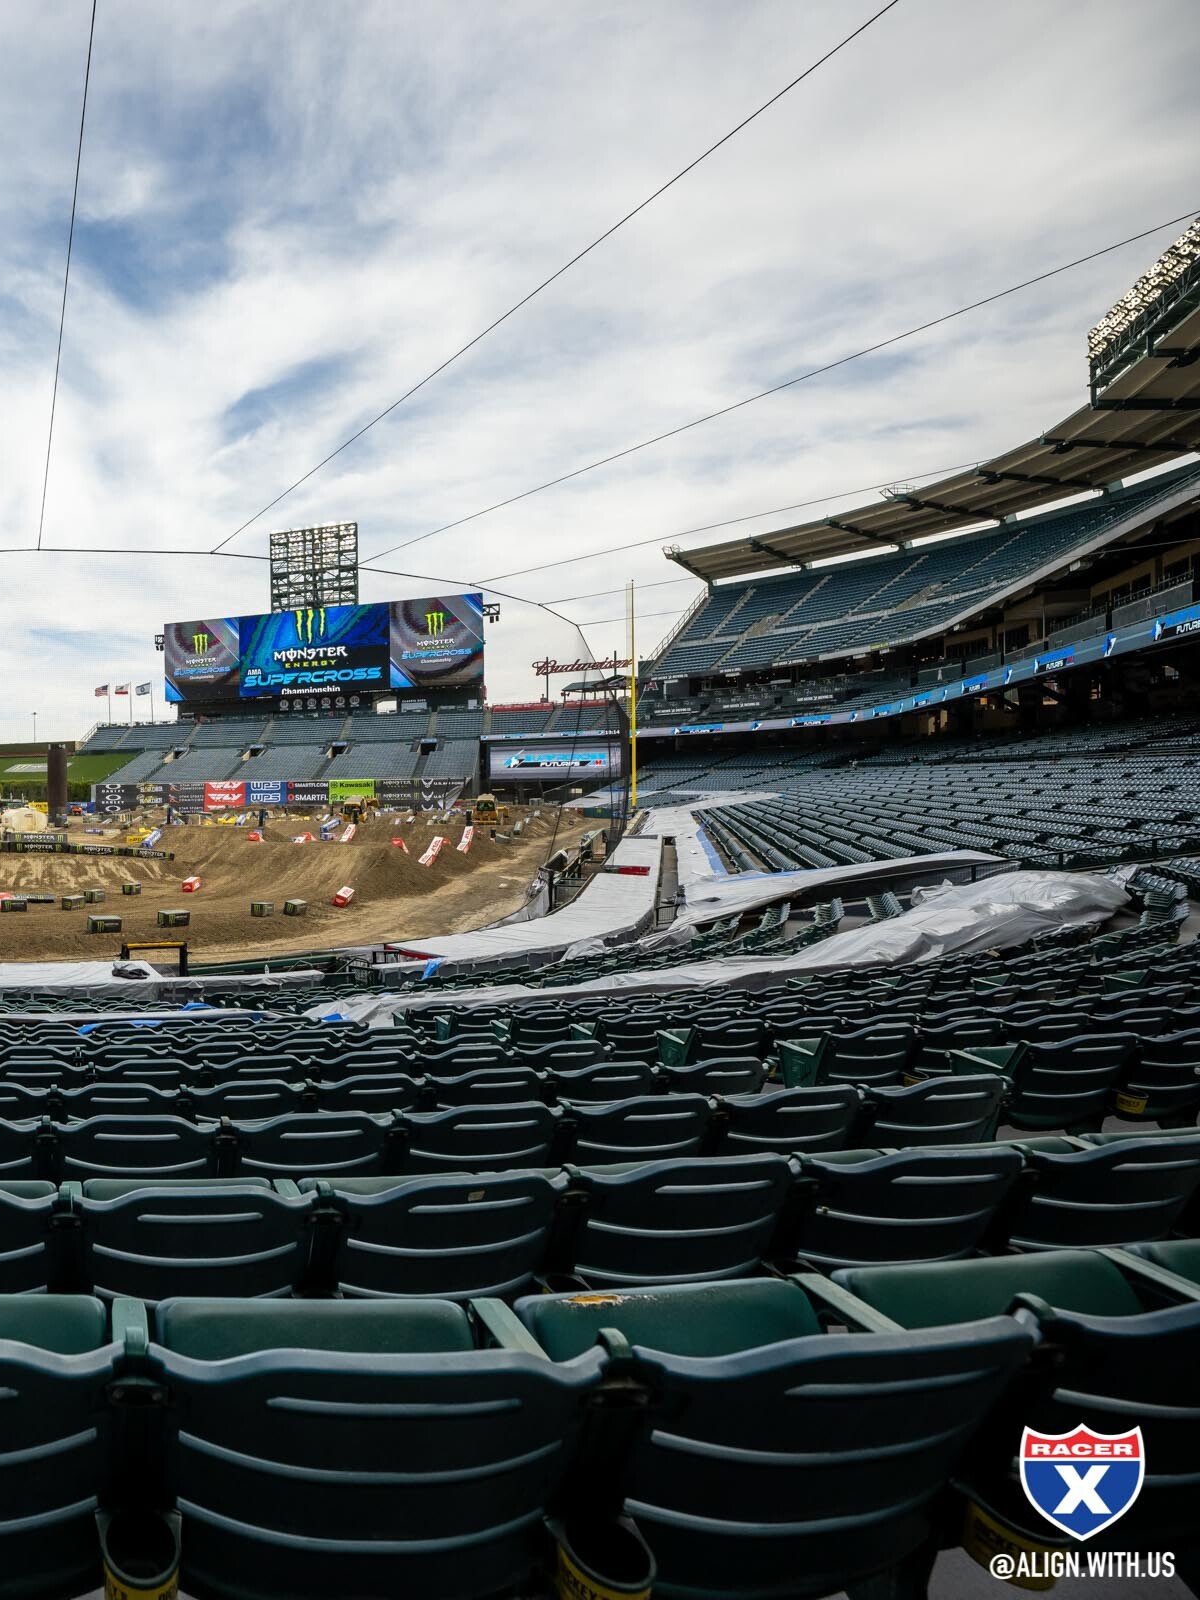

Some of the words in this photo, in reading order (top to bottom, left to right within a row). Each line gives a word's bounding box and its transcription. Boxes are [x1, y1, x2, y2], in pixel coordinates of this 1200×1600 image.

[417, 638, 455, 648] MONSTER
[274, 646, 348, 662] MONSTER
[401, 648, 472, 660] SUPERCROSS
[284, 659, 338, 669] ENERGY
[532, 657, 633, 677] Budweiser
[243, 667, 382, 688] SUPERCROSS
[251, 781, 280, 790] WPS
[251, 793, 280, 802] WPS
